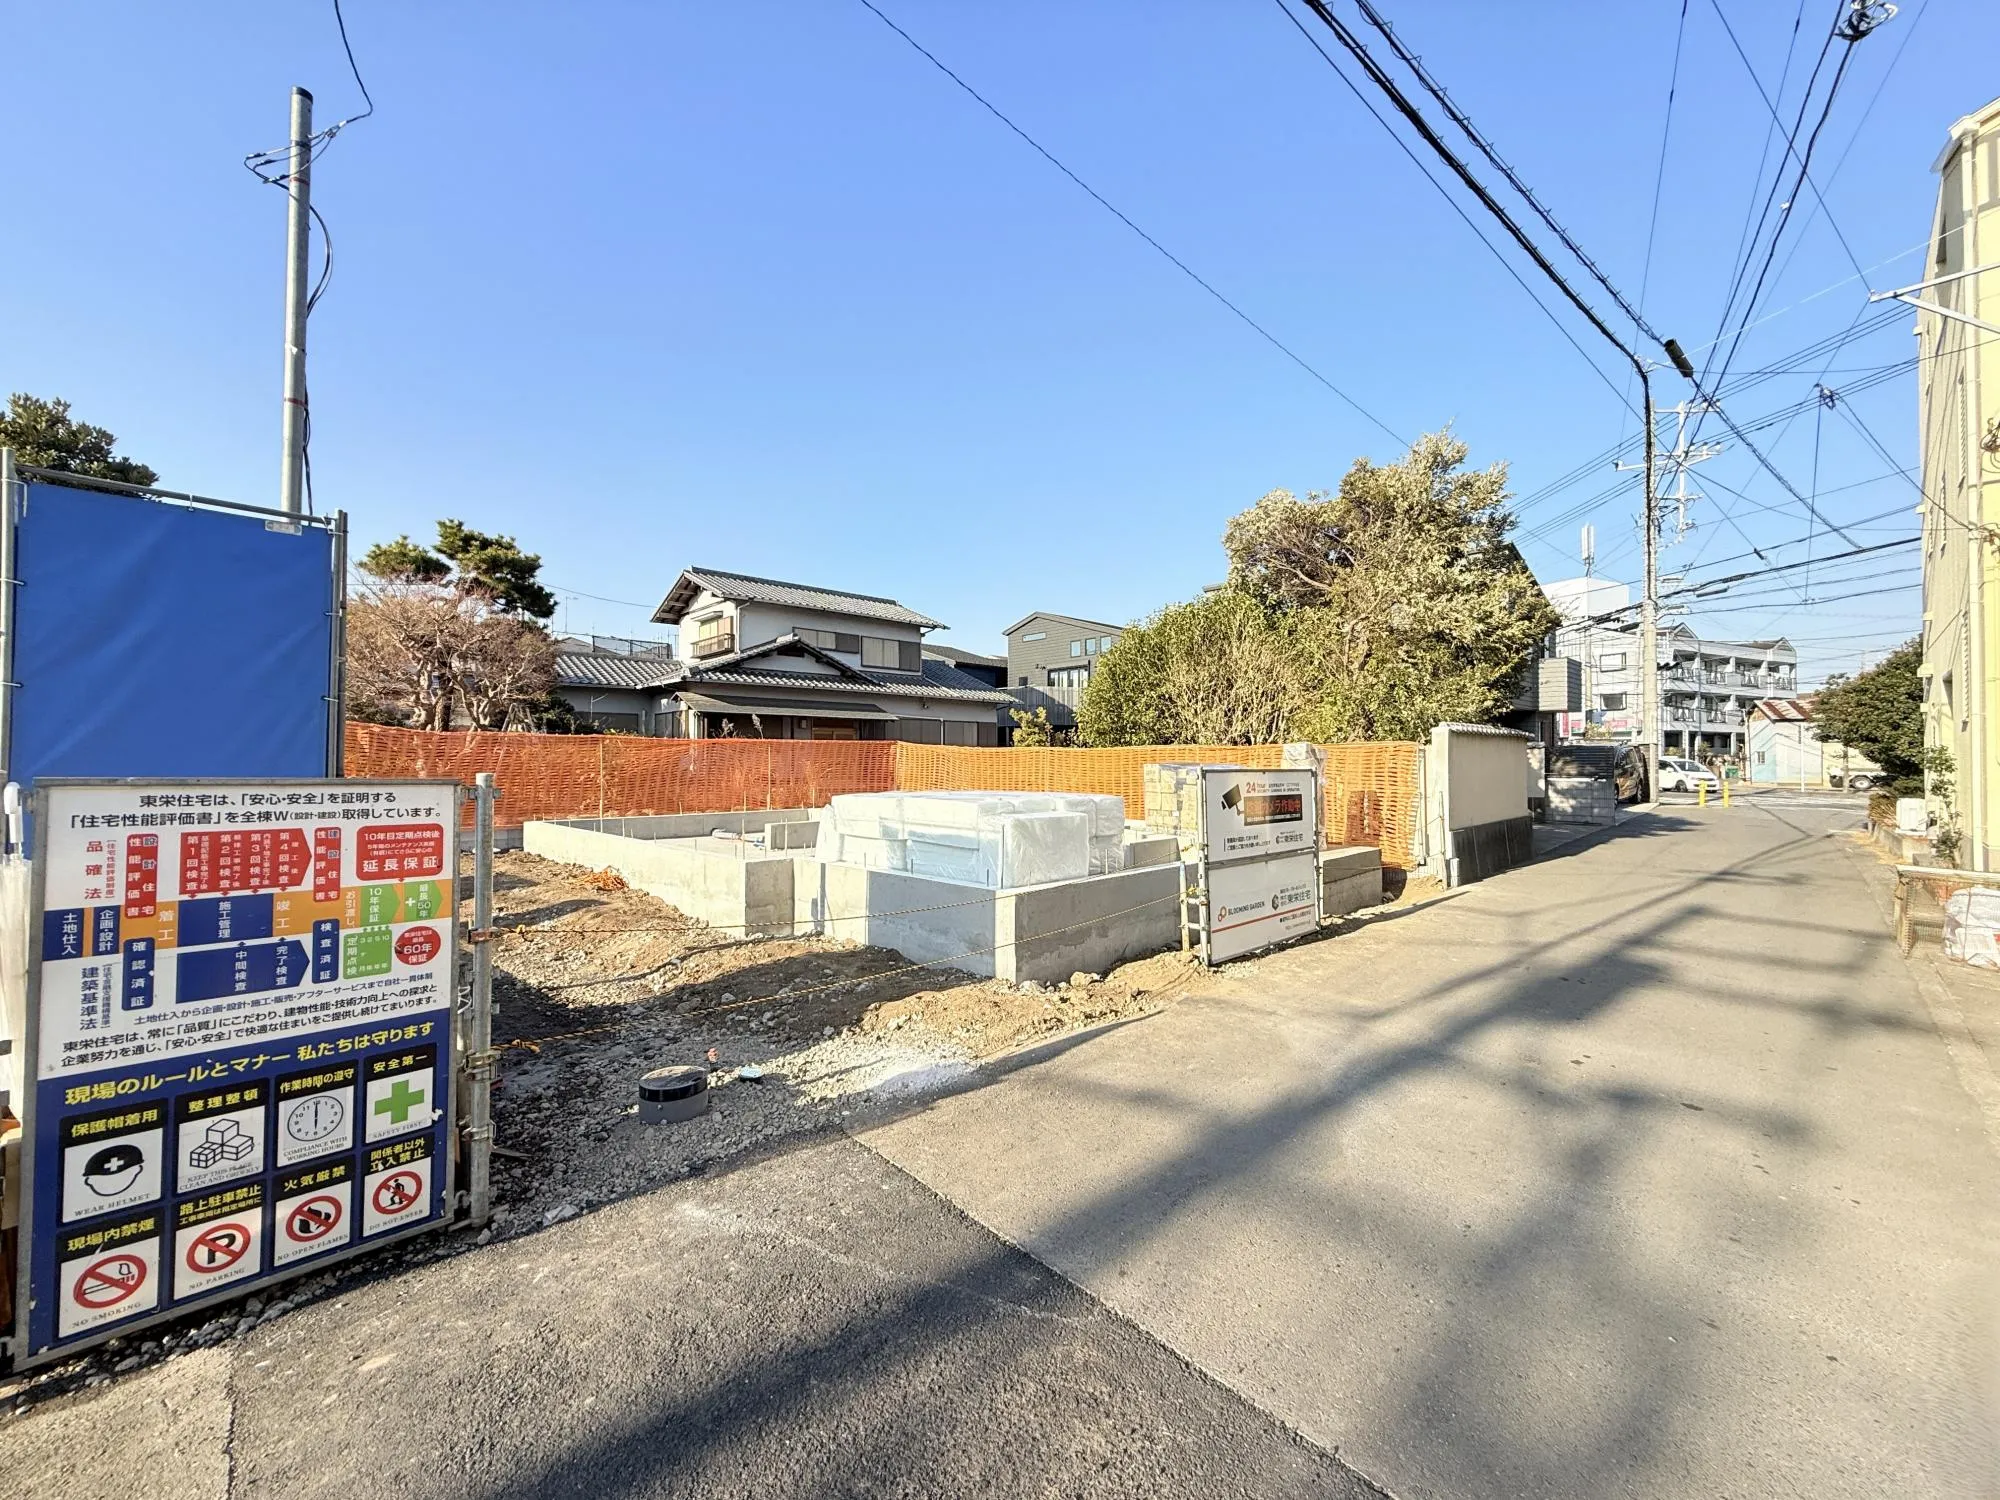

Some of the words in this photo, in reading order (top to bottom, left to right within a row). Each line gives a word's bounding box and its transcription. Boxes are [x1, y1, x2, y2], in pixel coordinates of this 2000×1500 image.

[1246, 782, 1256, 794] 24
[83, 840, 103, 900] 品確法
[185, 835, 199, 890] 第1回検査
[219, 834, 232, 889] 第2回検査
[249, 833, 261, 886] 第3回検査
[279, 832, 290, 884] 第4回検査
[362, 855, 438, 873] 延長保証
[368, 887, 382, 923] 10年保証
[1287, 889, 1311, 903] 東栄住宅
[98, 909, 115, 951] 企画・設計
[157, 909, 175, 941] 着工
[217, 900, 231, 939] 施工管理
[275, 900, 291, 928] 竣工
[61, 912, 78, 956] 土地仕入
[403, 943, 433, 955] 60年
[275, 945, 288, 985] 完了検査
[319, 922, 332, 980] 検査済証
[346, 935, 358, 976] 定期点検
[408, 953, 428, 965] 保証
[130, 941, 147, 1008] 確認済証
[234, 950, 247, 991] 中間検査
[79, 966, 99, 1031] 建築基準法
[65, 1053, 291, 1105] 現場のルールとマナー
[297, 1021, 435, 1061] 私たちは守ります
[373, 1054, 428, 1074] 安全第一
[279, 1067, 355, 1094] 作業時間の遵守
[188, 1087, 259, 1114] 整理整頓
[71, 1108, 158, 1138] 保護帽着用
[370, 1137, 425, 1162] 関係者以外
[370, 1148, 425, 1172] 立入禁止
[283, 1165, 346, 1192] 火気厳禁
[74, 1202, 105, 1218] WEAR
[108, 1193, 151, 1210] HELMET
[179, 1183, 262, 1217] 路上駐車禁止
[67, 1217, 155, 1252] 現場内禁煙
[277, 1252, 290, 1262] NO
[292, 1244, 315, 1257] OPEN
[317, 1233, 349, 1249] FLAMES
[188, 1280, 203, 1291] NO
[206, 1267, 246, 1286] PARKING
[72, 1318, 89, 1330] NO
[91, 1302, 142, 1320] SMOKING
